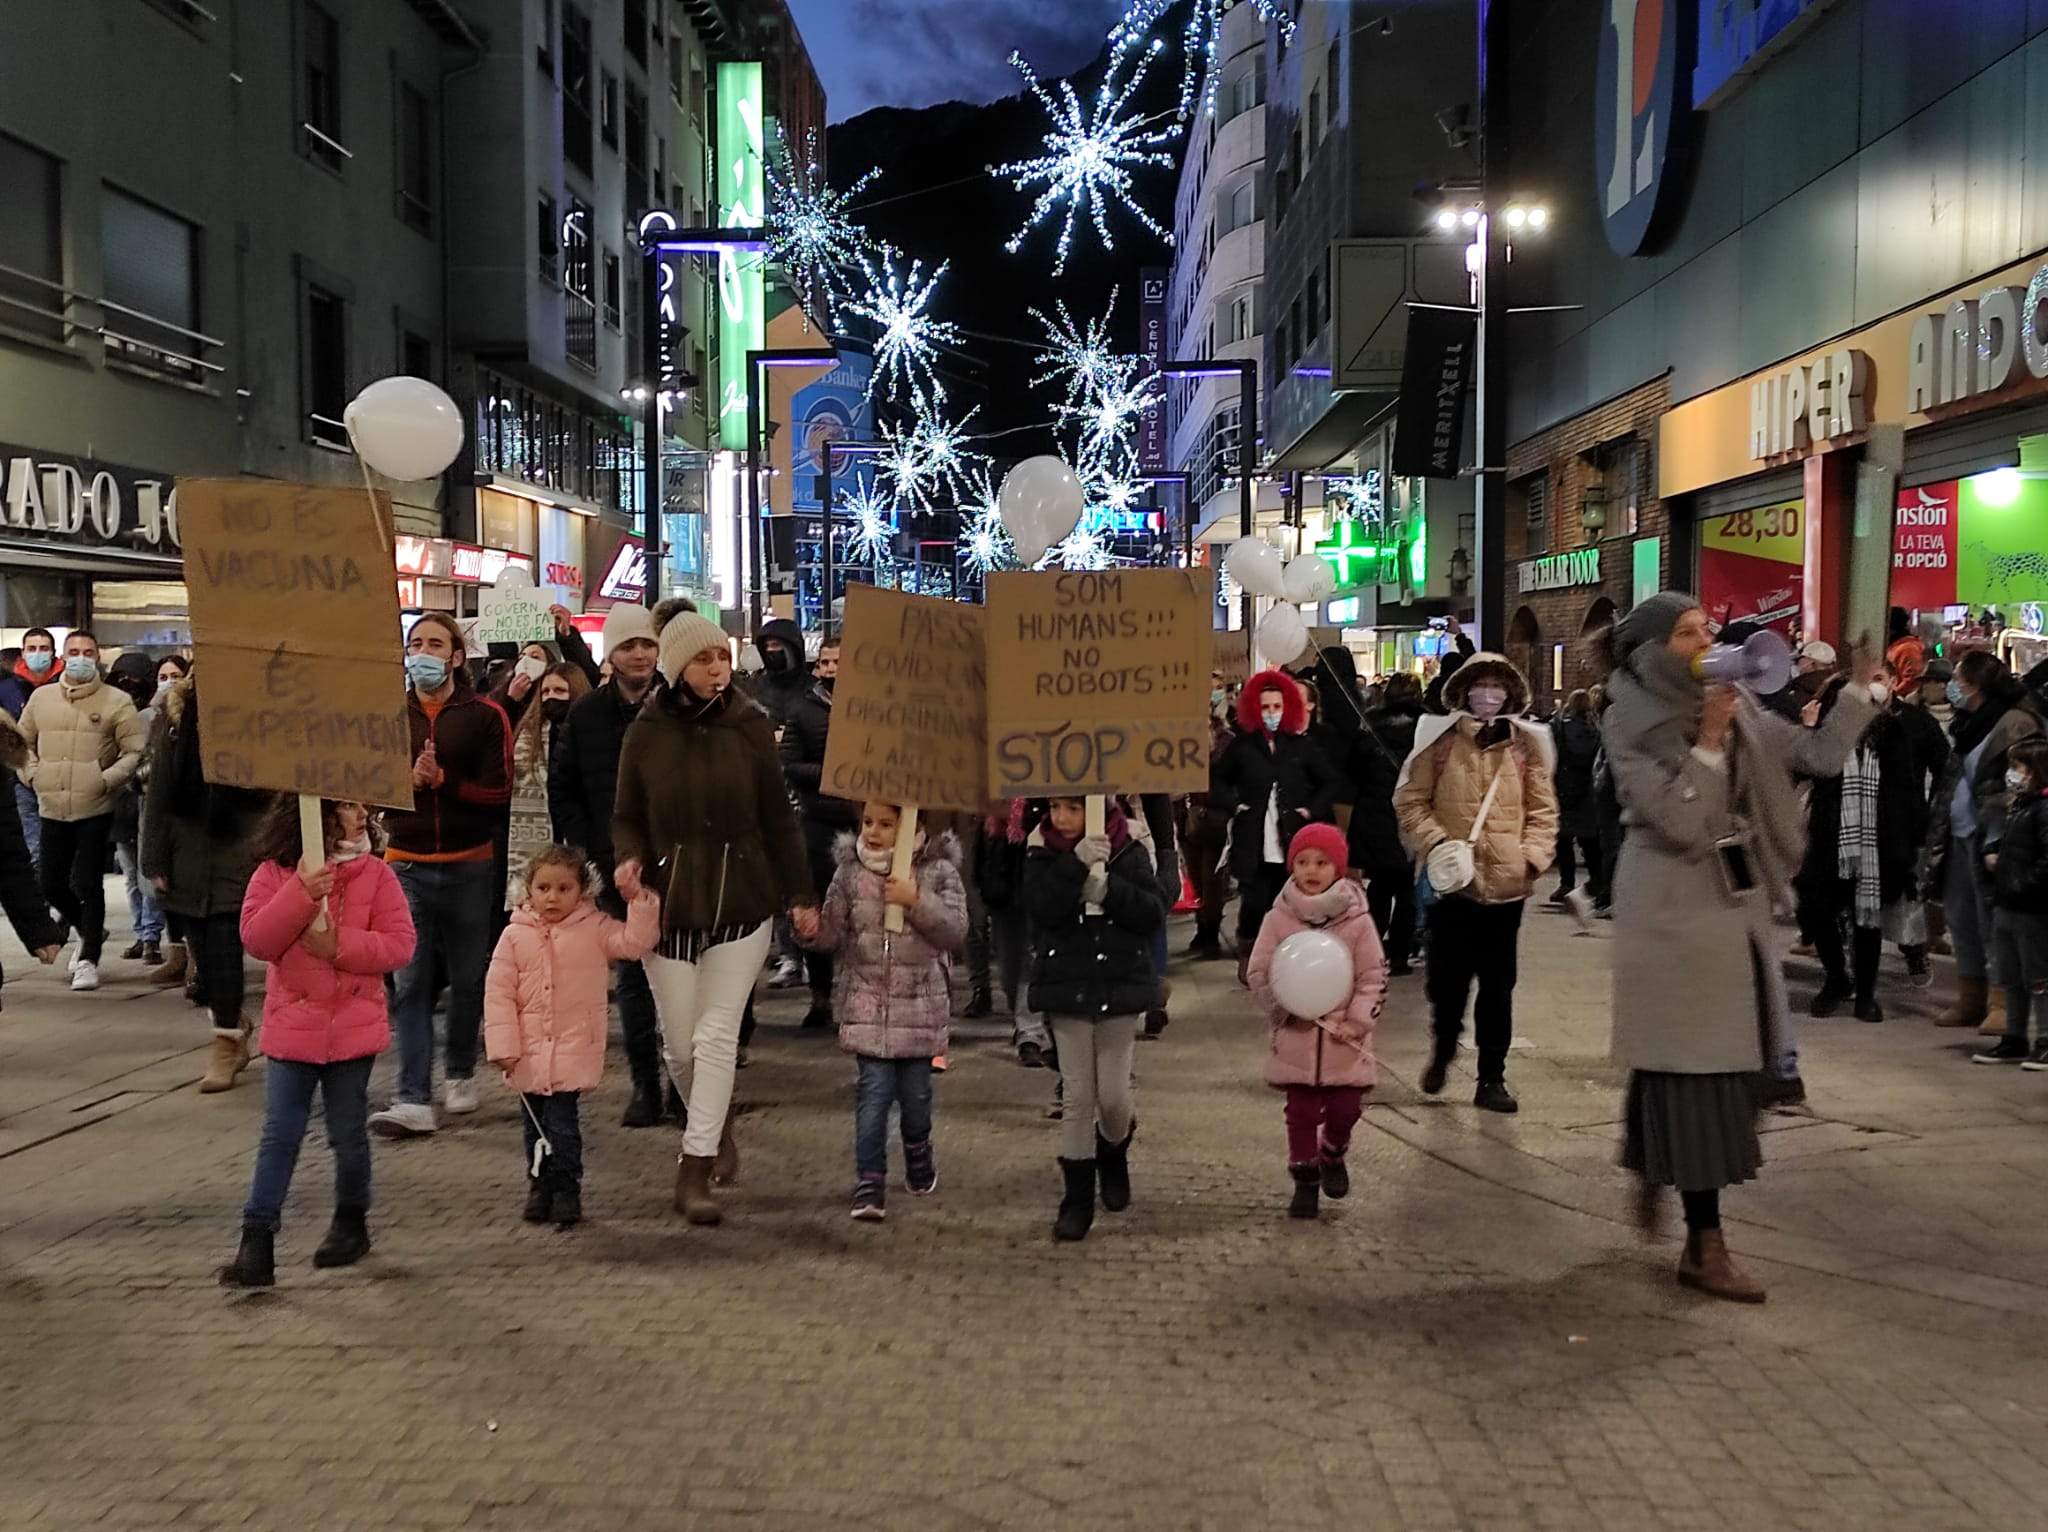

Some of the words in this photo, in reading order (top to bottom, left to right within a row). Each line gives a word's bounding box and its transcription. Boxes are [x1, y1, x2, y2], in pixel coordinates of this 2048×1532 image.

[1432, 342, 1463, 470] MERITXELL
[1752, 350, 1860, 461] HIPER
[1719, 507, 1799, 543] 28,30
[1900, 534, 1914, 550] LA
[1917, 534, 1945, 550] TEVA
[197, 547, 369, 598] VACUNA
[1535, 555, 1569, 591] CELLAR
[1569, 548, 1600, 586] DOOR
[1906, 550, 1948, 568] OPCIÓ
[1055, 573, 1123, 606] SOM
[484, 601, 539, 617] GOVERN
[1063, 647, 1100, 680] NO
[997, 719, 1127, 784] STOP
[1144, 737, 1205, 770] QR
